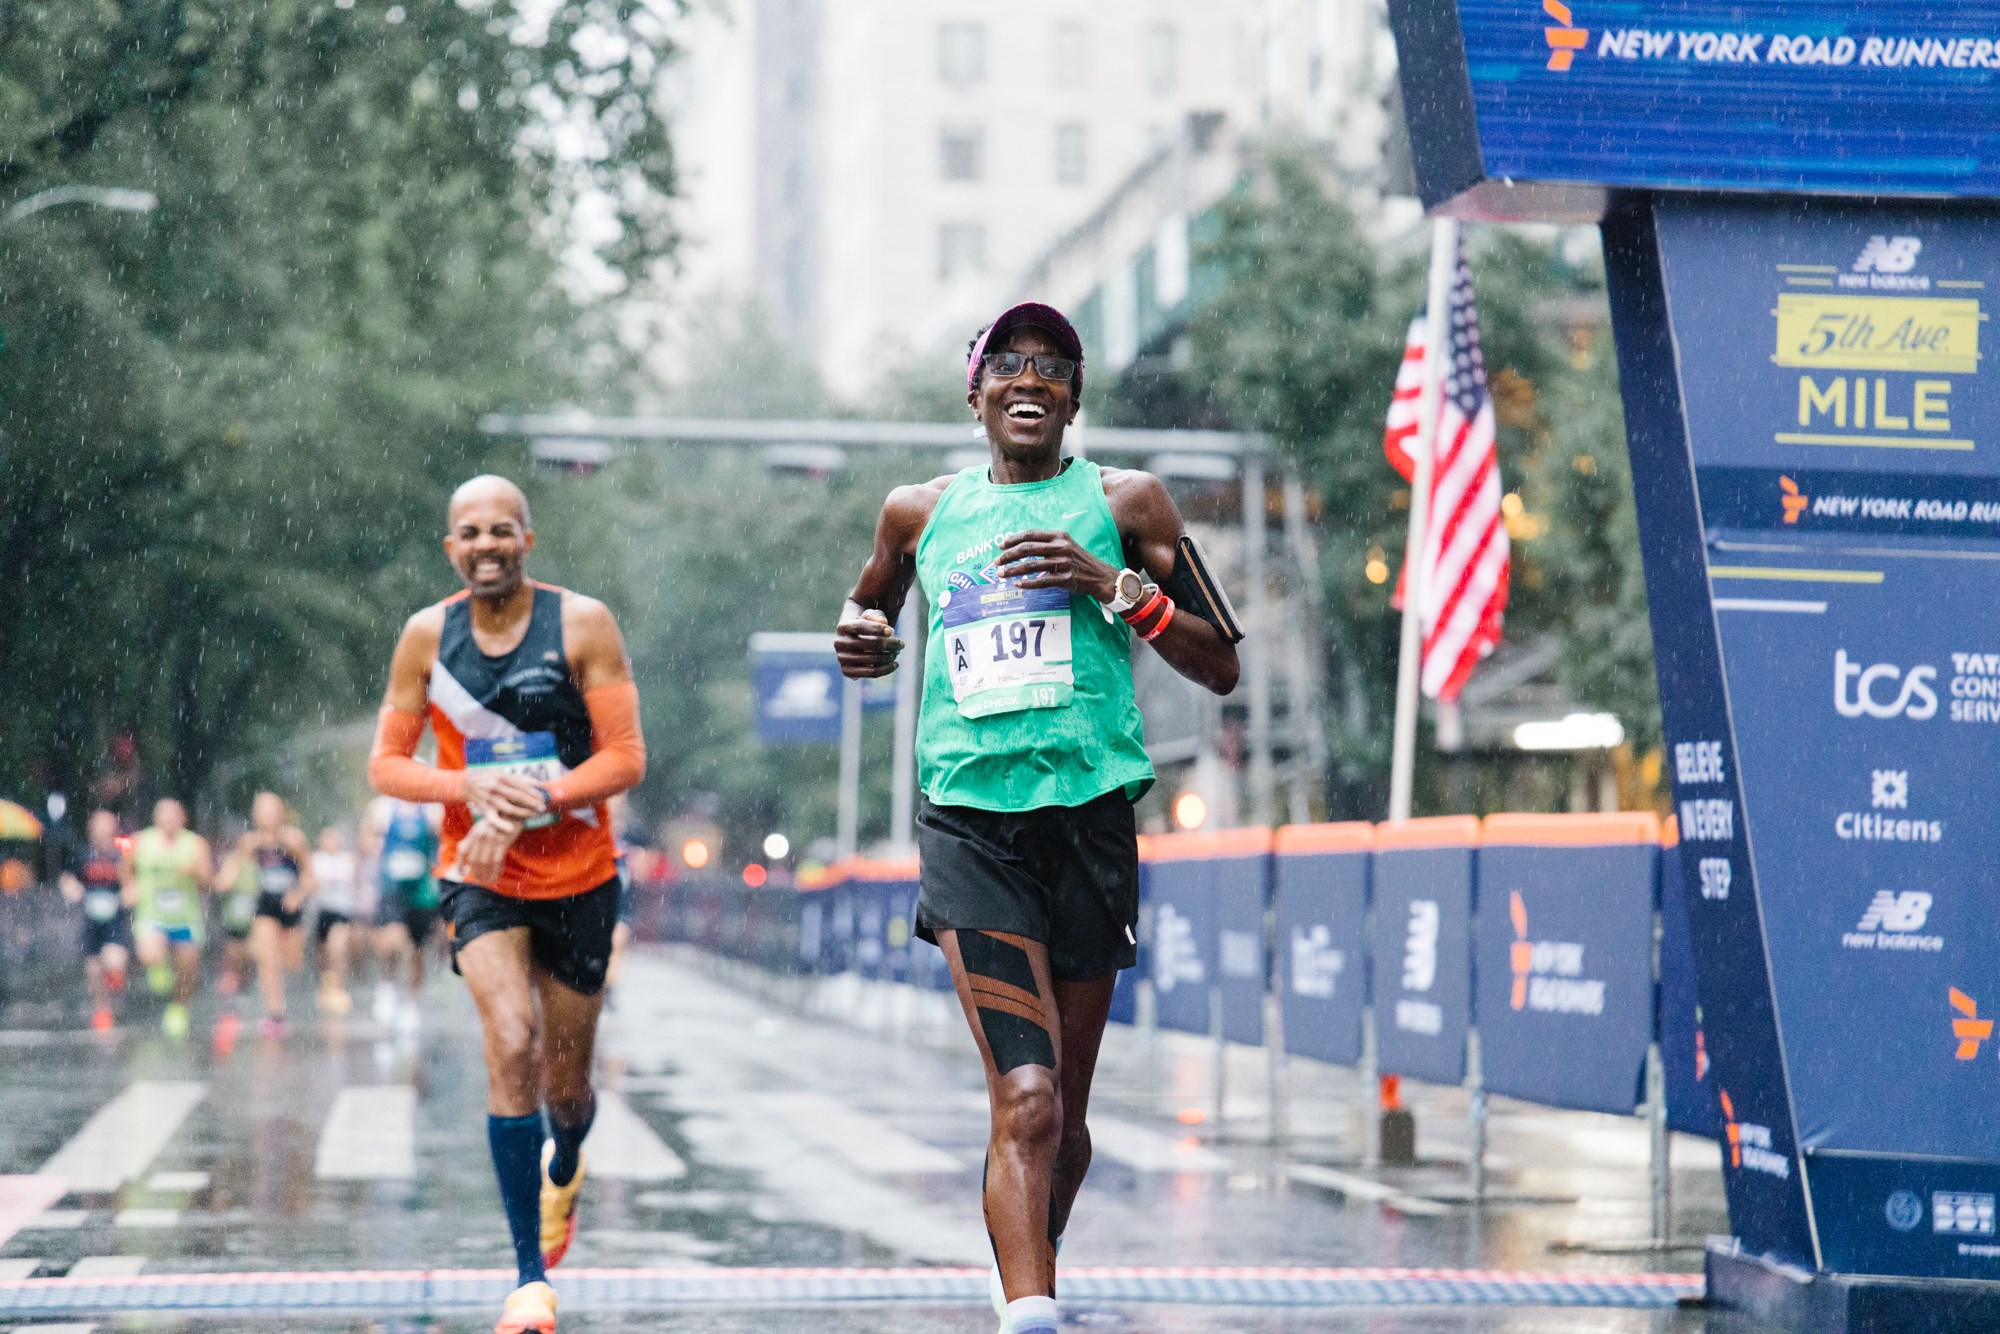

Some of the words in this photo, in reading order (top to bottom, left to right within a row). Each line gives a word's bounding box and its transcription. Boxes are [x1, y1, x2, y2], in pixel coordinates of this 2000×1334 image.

[1599, 29, 1674, 60] NEW
[1678, 31, 1763, 63] YORK
[1767, 35, 1856, 66] ROAD
[1798, 312, 1874, 356] 5th
[1798, 375, 1952, 431] MILE
[1813, 495, 1859, 517] NEW
[1861, 496, 1912, 519] YORK
[1914, 499, 1968, 522] ROAD
[956, 539, 993, 564] BANK
[950, 573, 974, 589] CHI
[955, 638, 965, 655] A
[991, 620, 1046, 662] 197
[958, 655, 968, 671] A
[1951, 652, 2000, 675] TAT
[1031, 687, 1056, 706] 197
[1834, 648, 1938, 720] tcs
[1950, 676, 2000, 699] CON
[966, 703, 982, 714] BAG
[984, 695, 1019, 709] CHECK
[1835, 812, 1942, 843] Citizens
[1699, 858, 1731, 899] STEP
[1842, 932, 1876, 949] new
